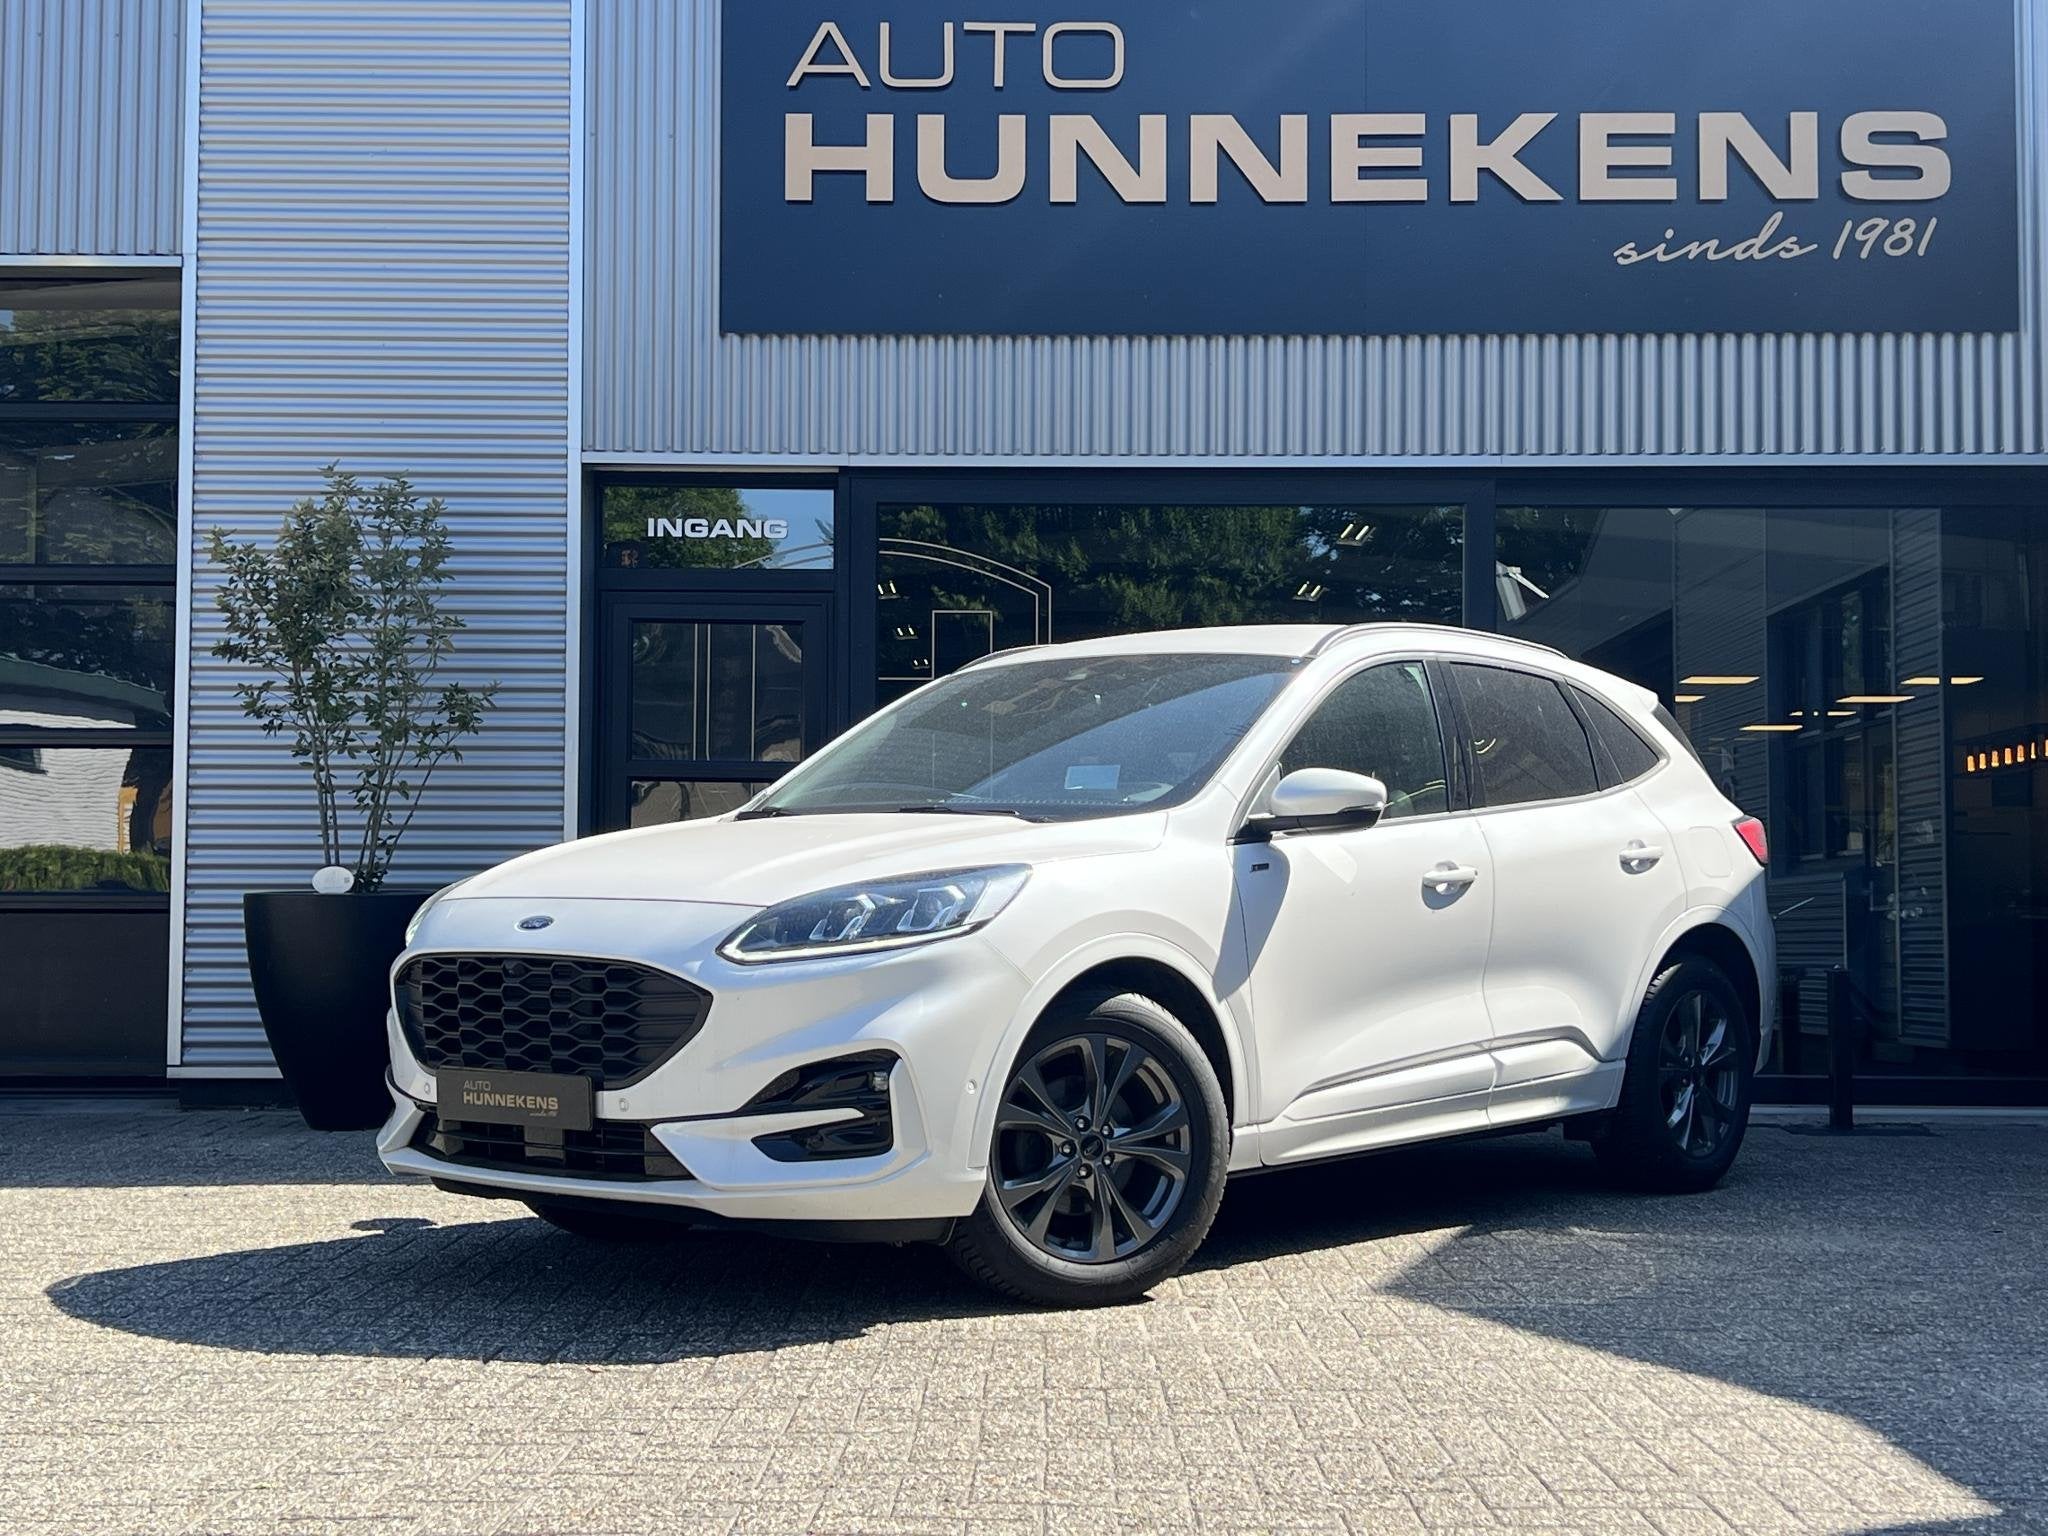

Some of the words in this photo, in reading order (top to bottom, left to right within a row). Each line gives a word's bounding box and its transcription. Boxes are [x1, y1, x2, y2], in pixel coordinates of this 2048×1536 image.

[785, 21, 1125, 89] AUTO
[784, 110, 1952, 205] HUNNEKENS
[1613, 211, 1818, 265] sinds
[1832, 217, 1938, 260] 1981
[647, 517, 789, 539] INGANG
[463, 1080, 492, 1091] AUTO
[463, 1091, 559, 1110] HUNNEKENS
